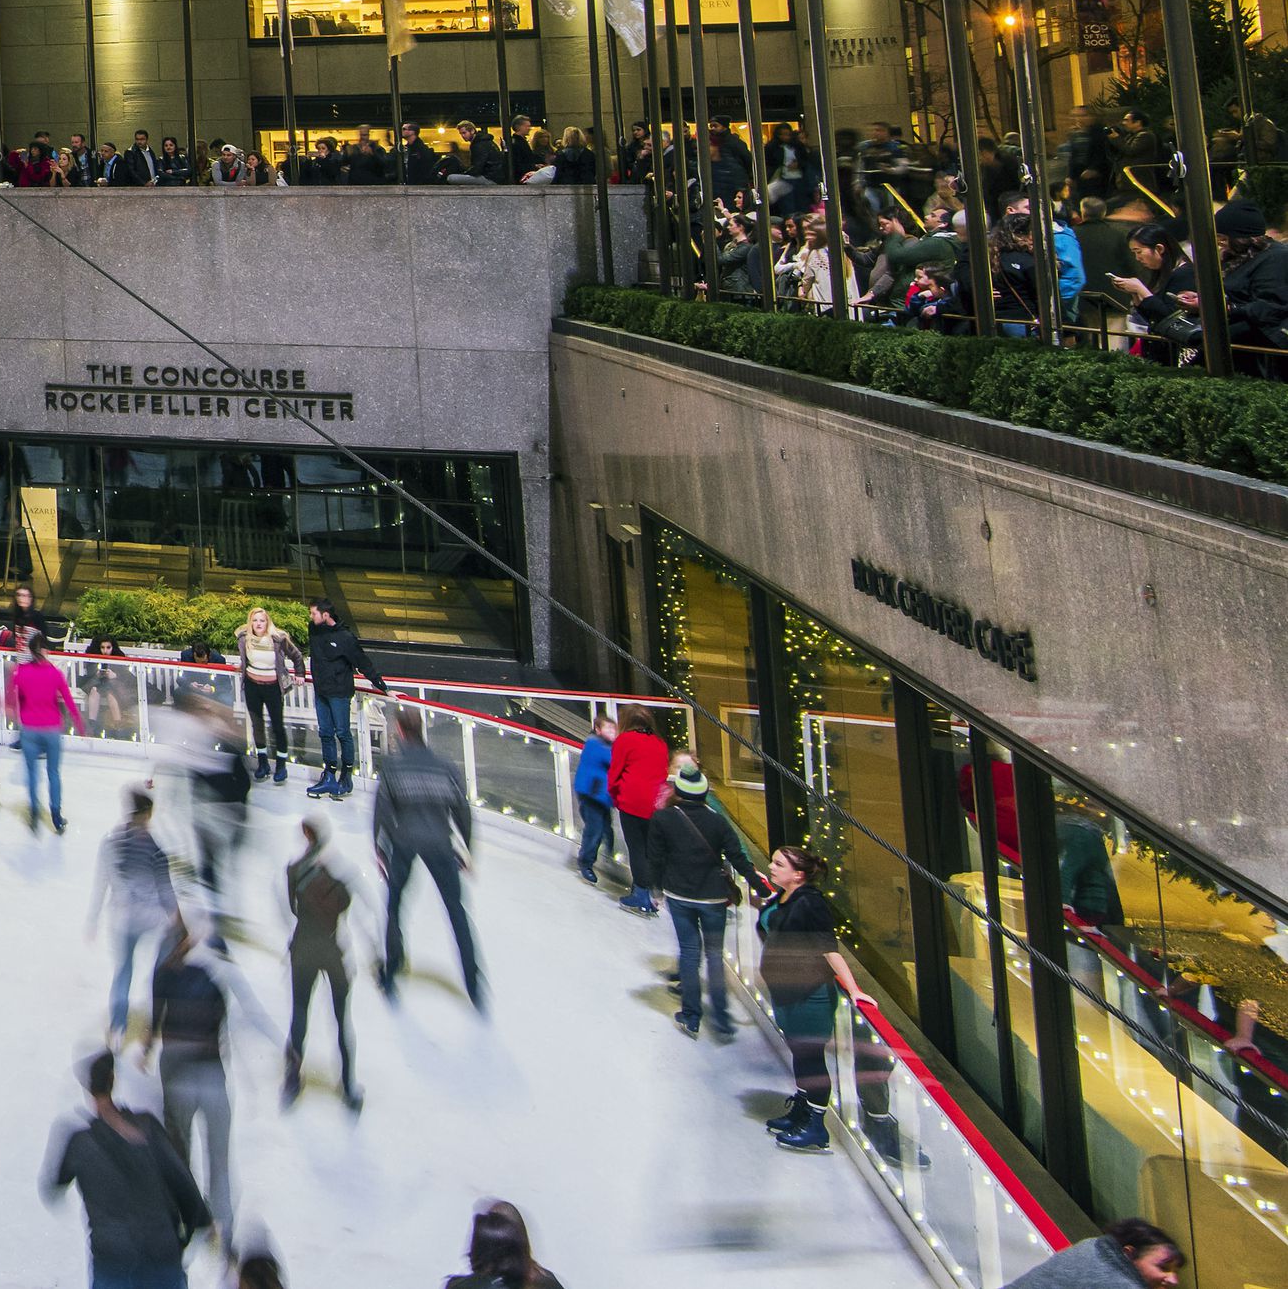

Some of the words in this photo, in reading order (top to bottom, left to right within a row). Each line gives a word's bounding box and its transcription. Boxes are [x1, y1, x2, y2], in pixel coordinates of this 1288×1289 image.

[1084, 24, 1109, 34] TOP
[86, 364, 133, 385] THE
[143, 365, 307, 390] CONCOURSE
[45, 391, 231, 418] ROCKEFELLER
[244, 398, 355, 421] CENTER
[28, 507, 56, 515] AZARD
[896, 580, 974, 650] CENTER
